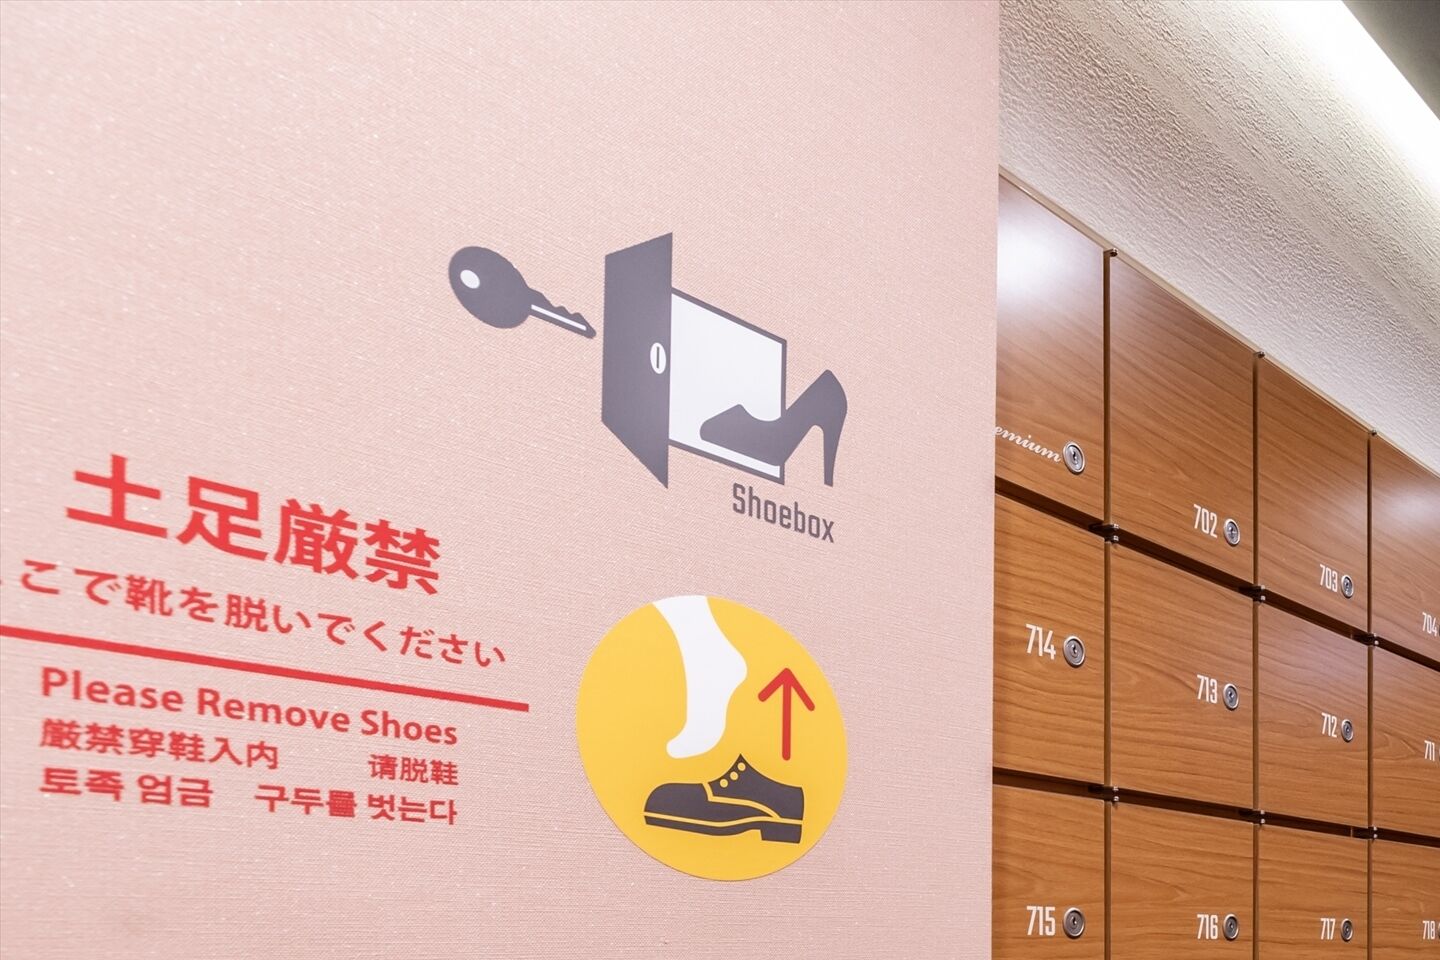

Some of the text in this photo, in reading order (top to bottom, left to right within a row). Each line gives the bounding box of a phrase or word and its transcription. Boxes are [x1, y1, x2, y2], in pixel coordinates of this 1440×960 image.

[995, 426, 1062, 463] emium
[66, 454, 441, 595] 土足厳禁
[732, 482, 835, 543] Shoebox
[1193, 503, 1218, 539] 702
[1319, 563, 1338, 593] 703
[0, 559, 506, 668] こで靴を脱いでください
[1422, 611, 1438, 637] 704
[1025, 623, 1057, 660] 714
[1196, 674, 1218, 704] 713
[41, 667, 458, 746] Please Remove Shoes
[1321, 712, 1338, 738] 712
[1424, 739, 1436, 762] 711
[368, 754, 459, 785] 请脱鞋
[39, 767, 458, 825] 토족 엄금 구두를 벗는다
[1026, 905, 1056, 936] 715
[1196, 913, 1219, 940] 716
[1320, 917, 1336, 940] 717
[1422, 920, 1436, 940] 718
